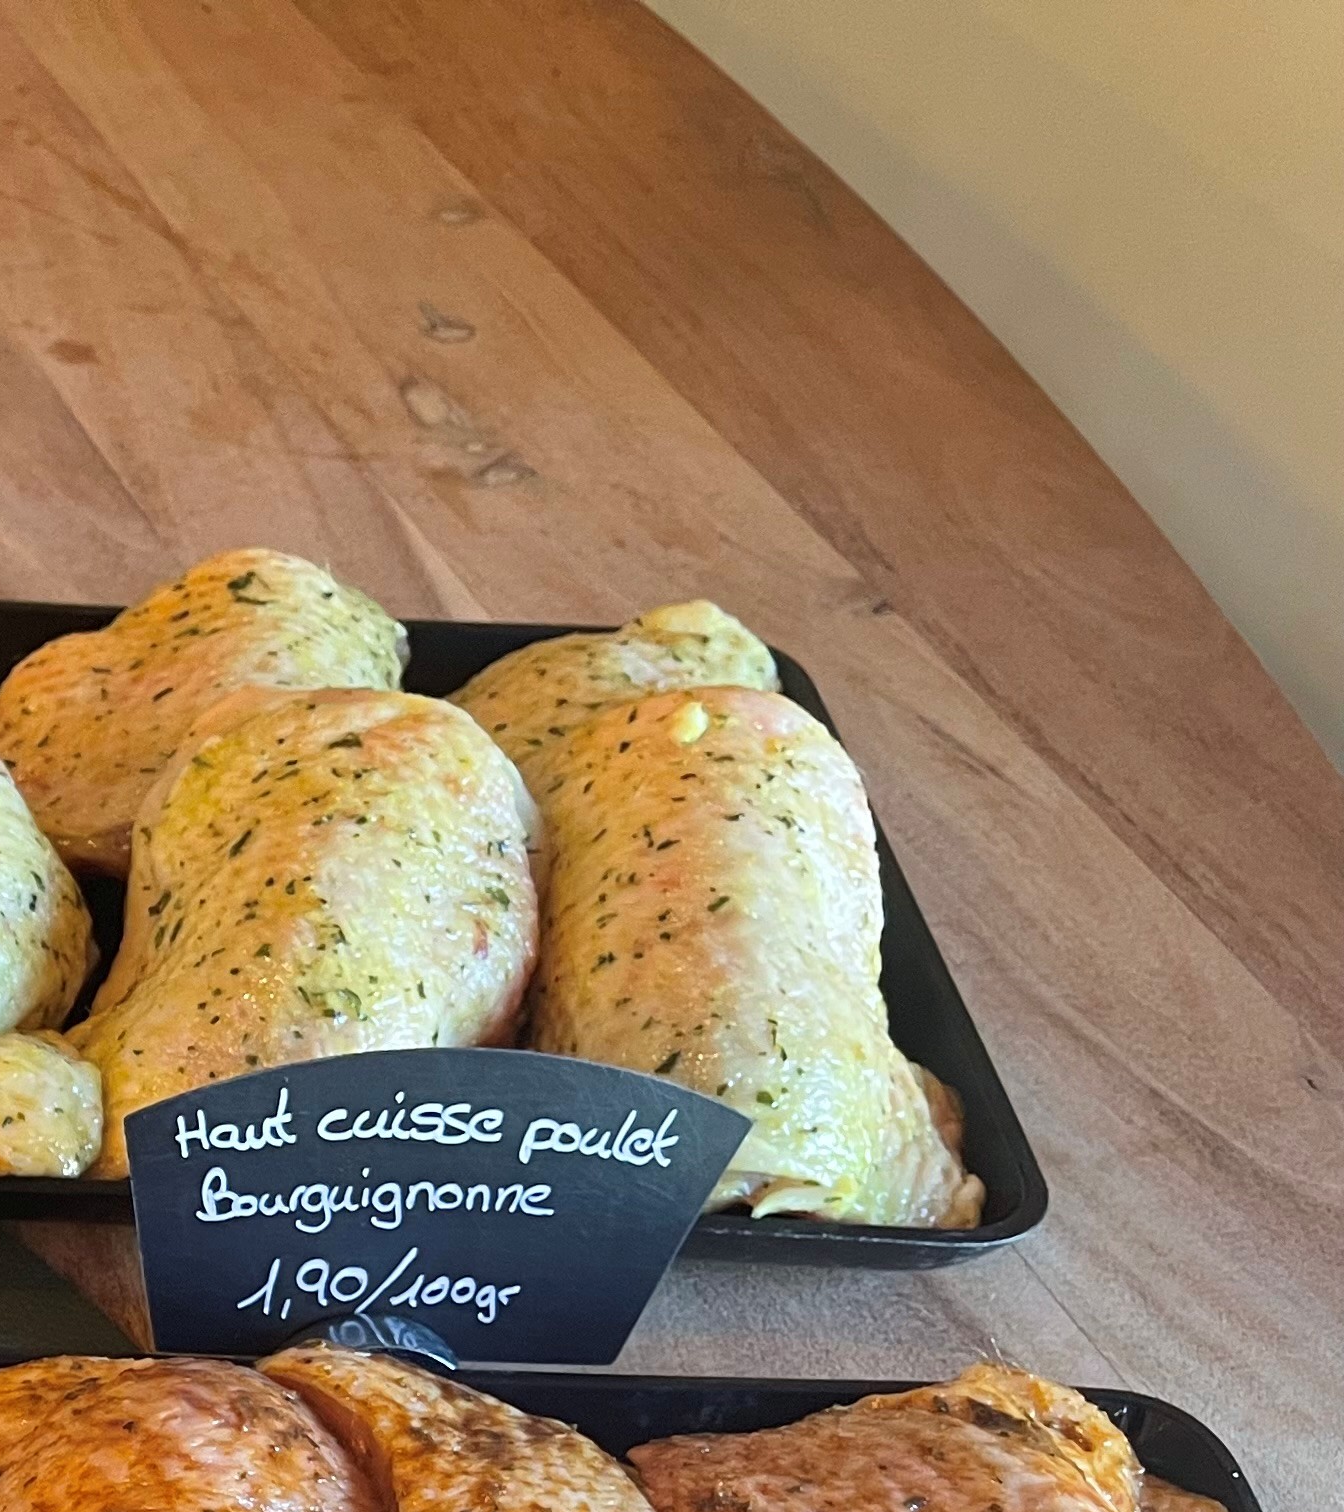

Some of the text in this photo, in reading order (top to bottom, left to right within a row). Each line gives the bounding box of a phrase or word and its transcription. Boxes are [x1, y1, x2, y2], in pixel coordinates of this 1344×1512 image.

[175, 1089, 680, 1166] Haut cuisse poulet
[195, 1167, 555, 1232] Bourguignonne
